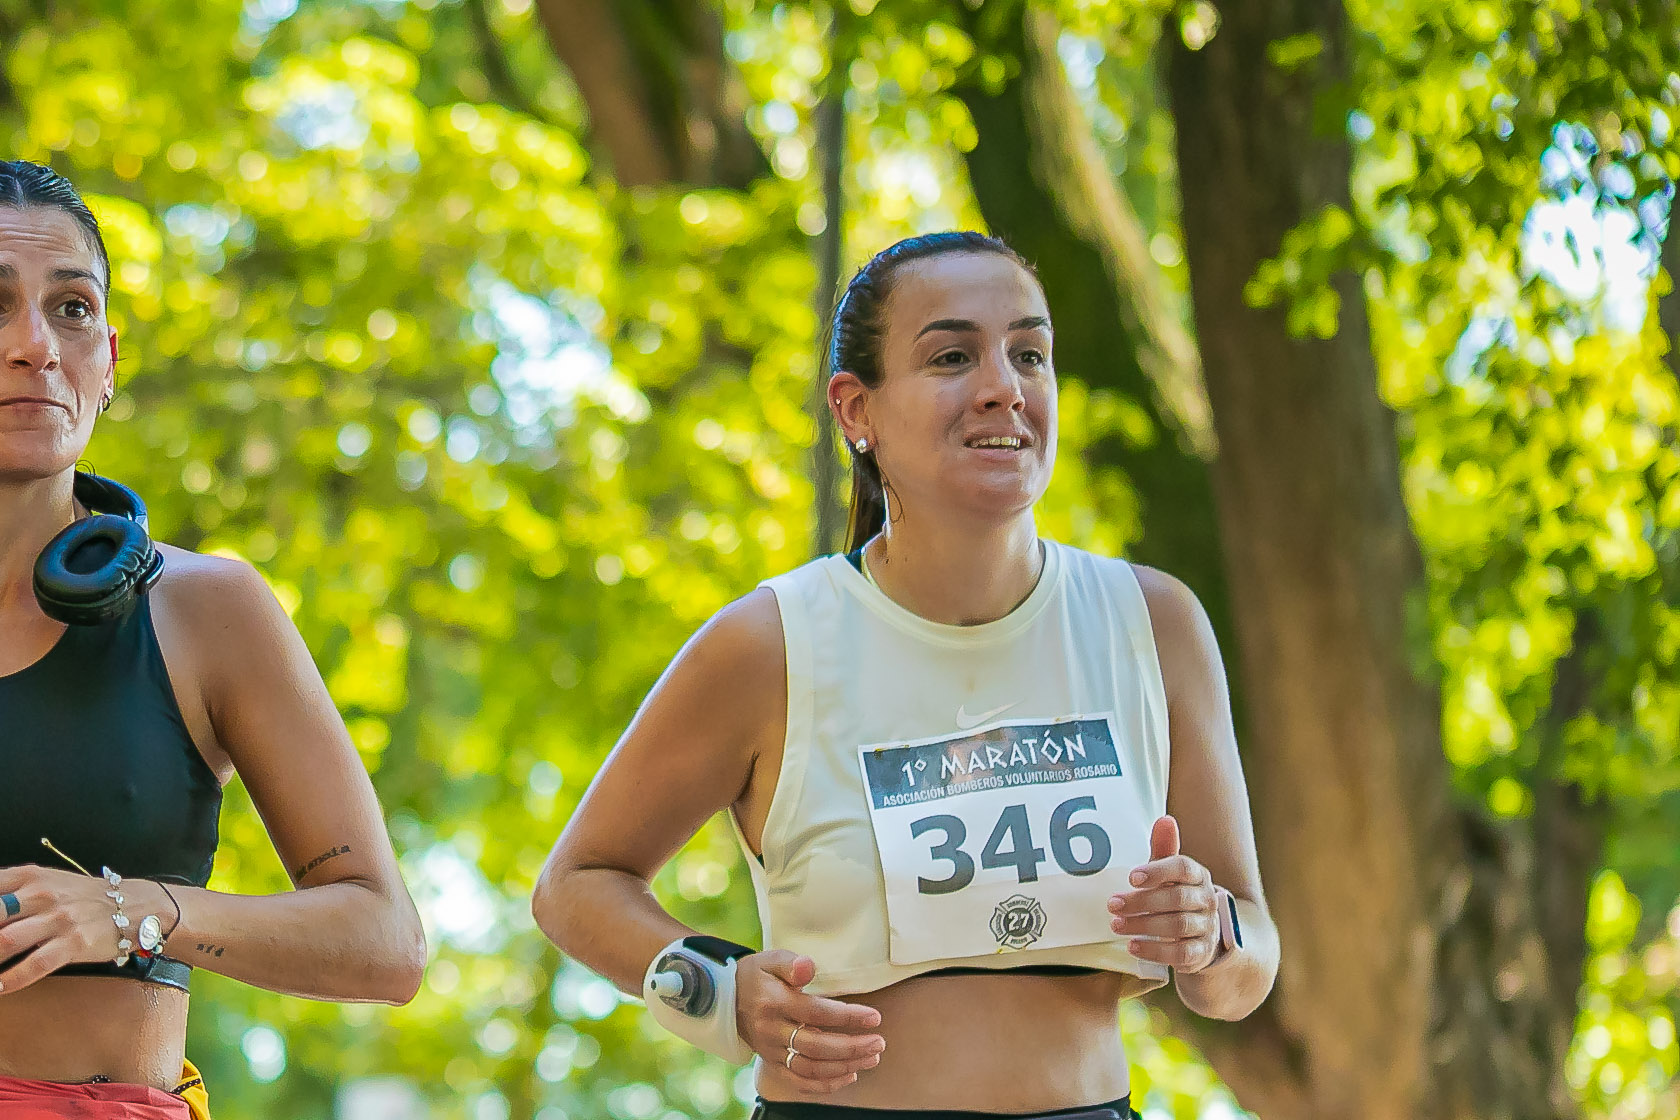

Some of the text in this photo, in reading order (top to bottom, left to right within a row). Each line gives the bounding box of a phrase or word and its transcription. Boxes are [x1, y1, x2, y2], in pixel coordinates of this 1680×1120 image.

[940, 729, 1087, 780] MARATÓN
[883, 763, 1118, 807] ASOCIACIÓN BOMBEROS VOLUNTARIOS ROSARIO
[910, 795, 1112, 895] 346
[1008, 911, 1030, 932] 27
